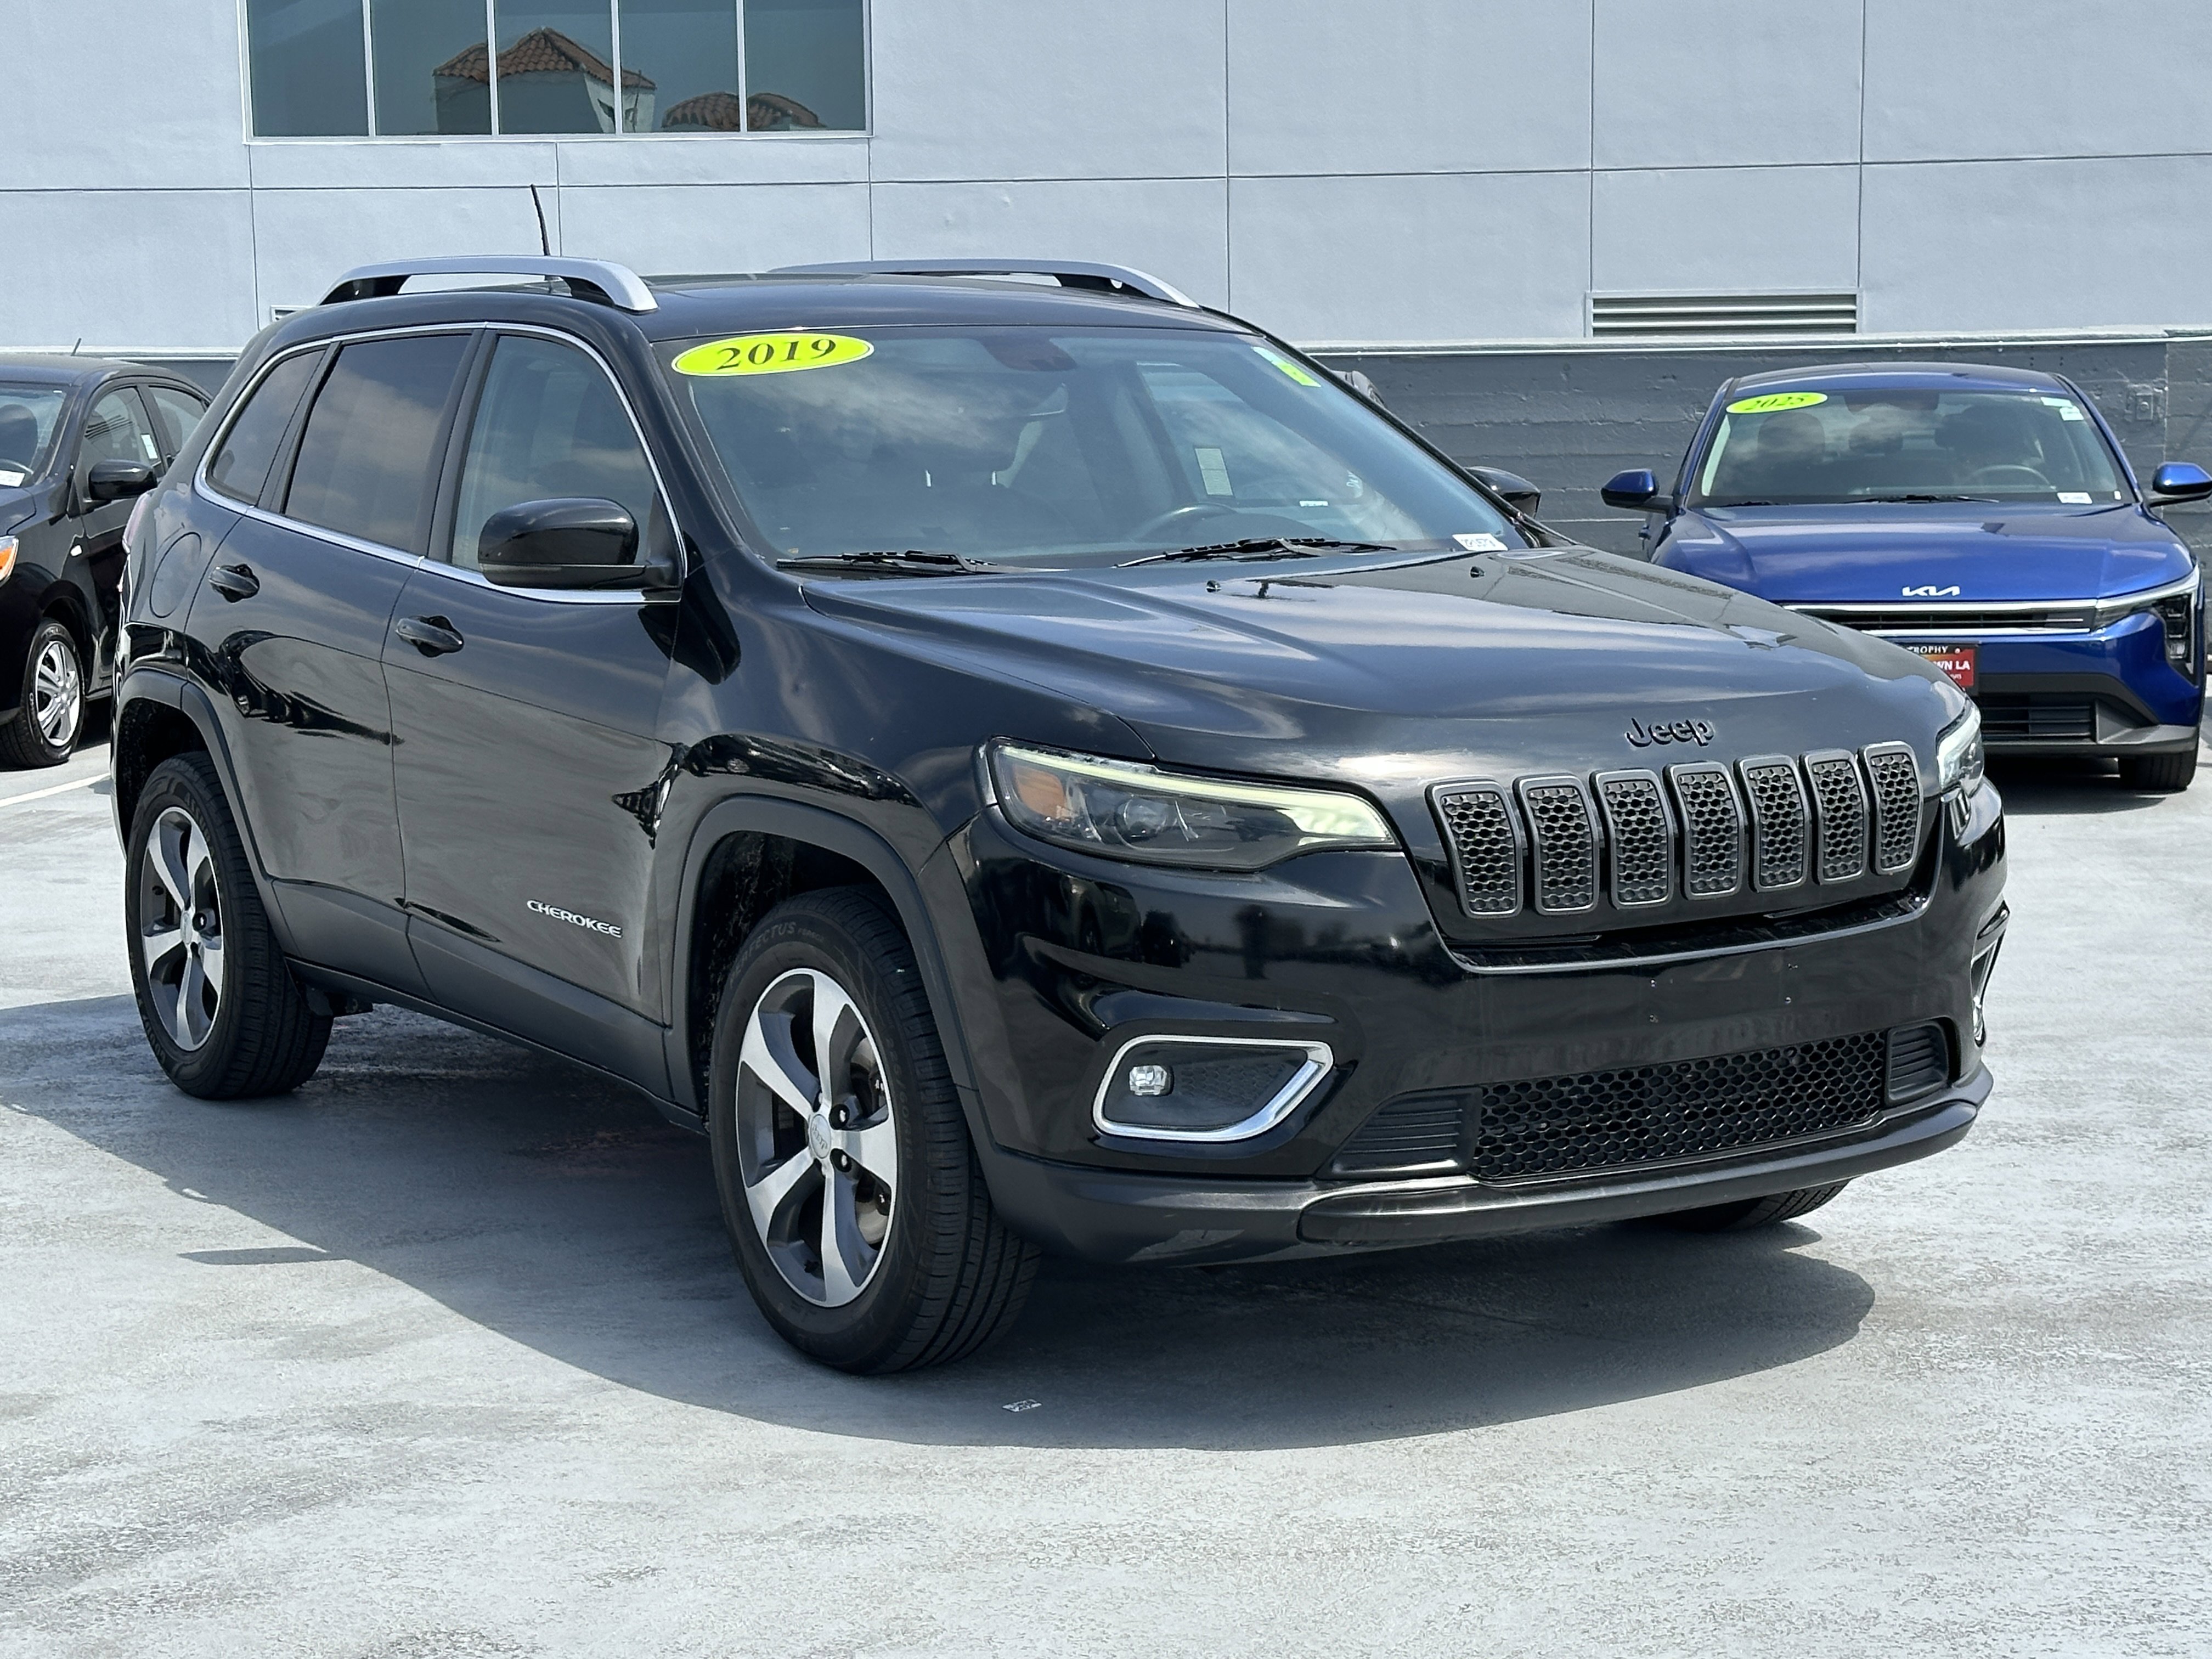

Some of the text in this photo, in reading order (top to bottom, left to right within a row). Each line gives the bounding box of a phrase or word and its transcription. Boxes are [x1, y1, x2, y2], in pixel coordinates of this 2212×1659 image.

[715, 338, 837, 370] 2019
[1744, 395, 1810, 410] 2025
[1956, 661, 1971, 670] LA
[1625, 718, 1715, 747] Jeep
[527, 900, 623, 938] CHEROKEE
